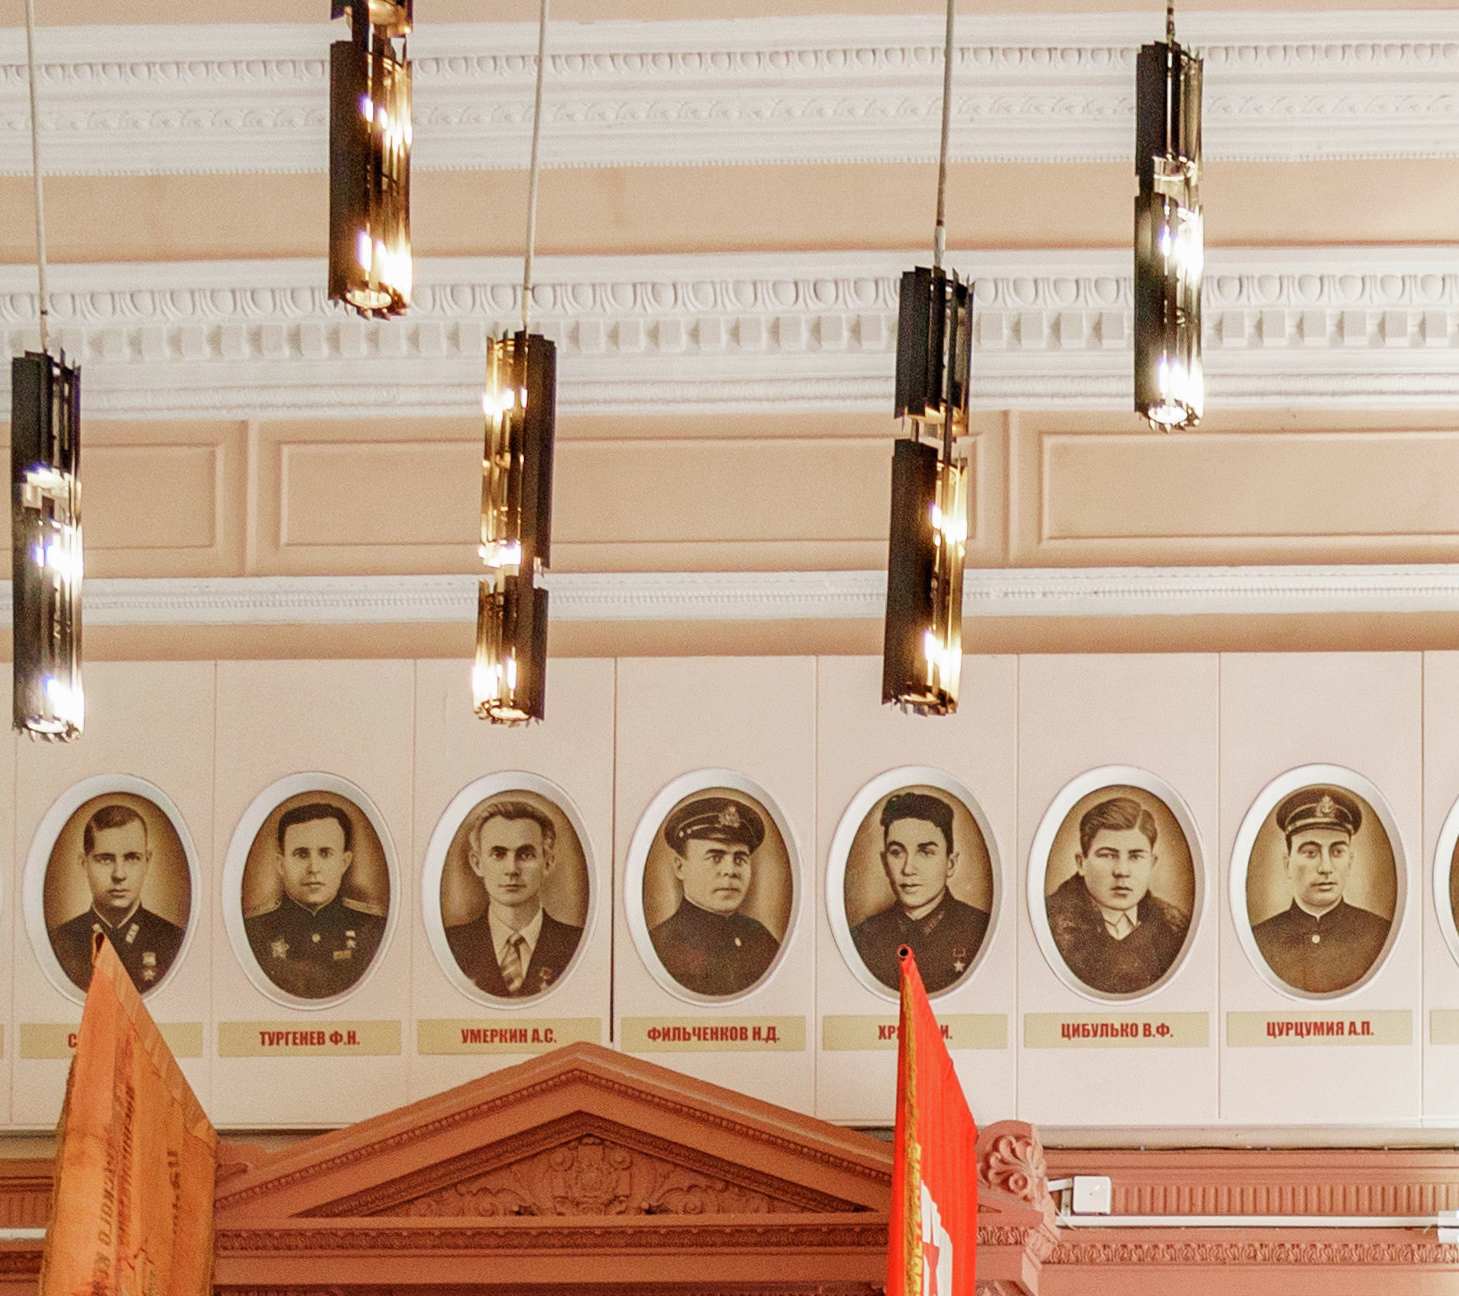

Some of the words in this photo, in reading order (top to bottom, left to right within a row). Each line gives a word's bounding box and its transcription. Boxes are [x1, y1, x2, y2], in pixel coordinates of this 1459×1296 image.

[258, 1030, 327, 1047] ТУРГЕНЕВ
[329, 1030, 361, 1046] Ф.Н.
[460, 1027, 529, 1045] УМЕРКИН
[530, 1027, 558, 1045] А.С.
[646, 1025, 750, 1043] ФИЛЬЧЕНКОВ
[751, 1026, 781, 1044] Н.Д.
[1060, 1022, 1140, 1041] ЦИБУЛЬКО
[1142, 1022, 1174, 1039] В.Ф.
[1266, 1020, 1344, 1039] ЦУРЦУМИЯ
[1347, 1020, 1375, 1038] А.П.
